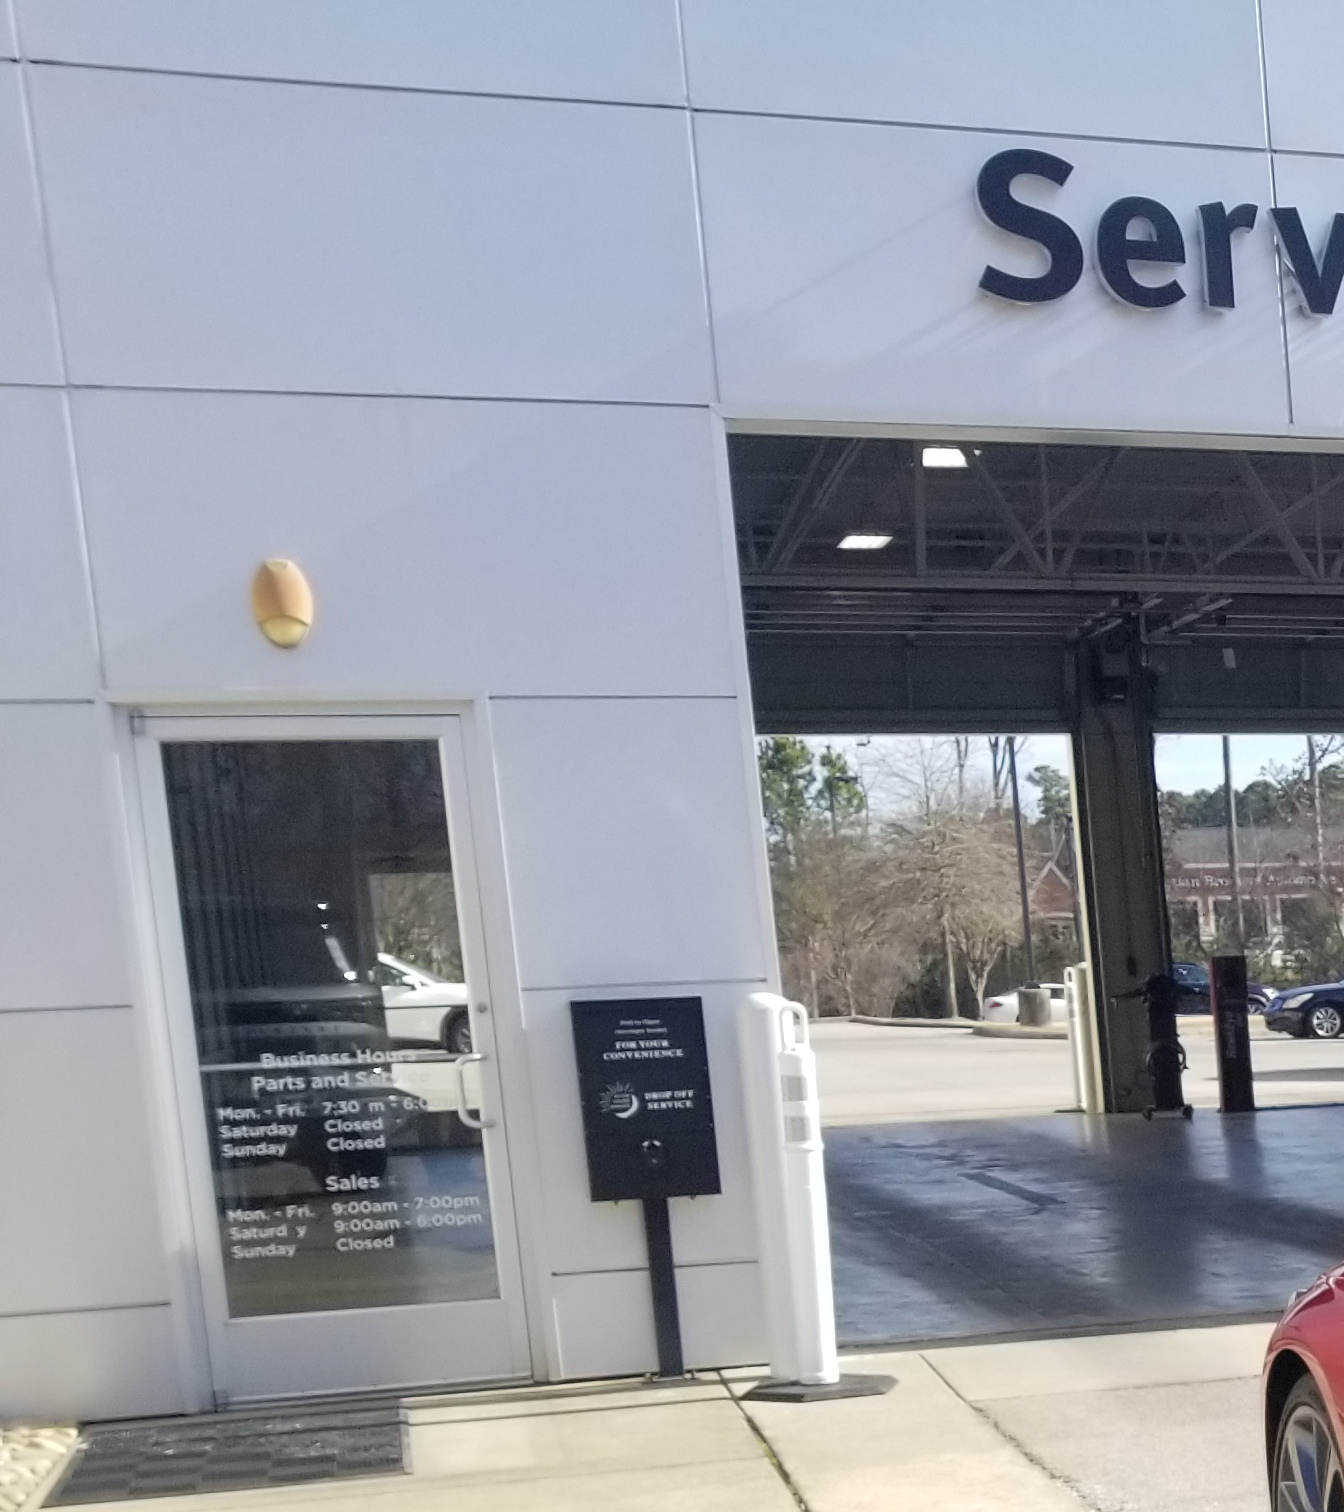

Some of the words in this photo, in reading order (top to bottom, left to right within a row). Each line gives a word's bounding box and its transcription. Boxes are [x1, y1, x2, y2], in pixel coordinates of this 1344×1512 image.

[260, 1051, 350, 1068] Business
[603, 1048, 684, 1060] CONVENIENCE
[253, 1074, 305, 1092] Parts
[311, 1072, 349, 1089] and
[219, 1122, 298, 1139] Saturday
[324, 1117, 384, 1133] Closed
[222, 1141, 287, 1159] Sunday
[326, 1135, 386, 1152] Closed
[325, 1174, 380, 1192] Sales
[331, 1201, 398, 1216] 9:00am
[414, 1195, 480, 1212] 7:00pm
[333, 1217, 400, 1234] 9:00am
[416, 1212, 482, 1229] 6:00pm
[231, 1242, 297, 1259] Sunday
[336, 1235, 395, 1252] Closed
